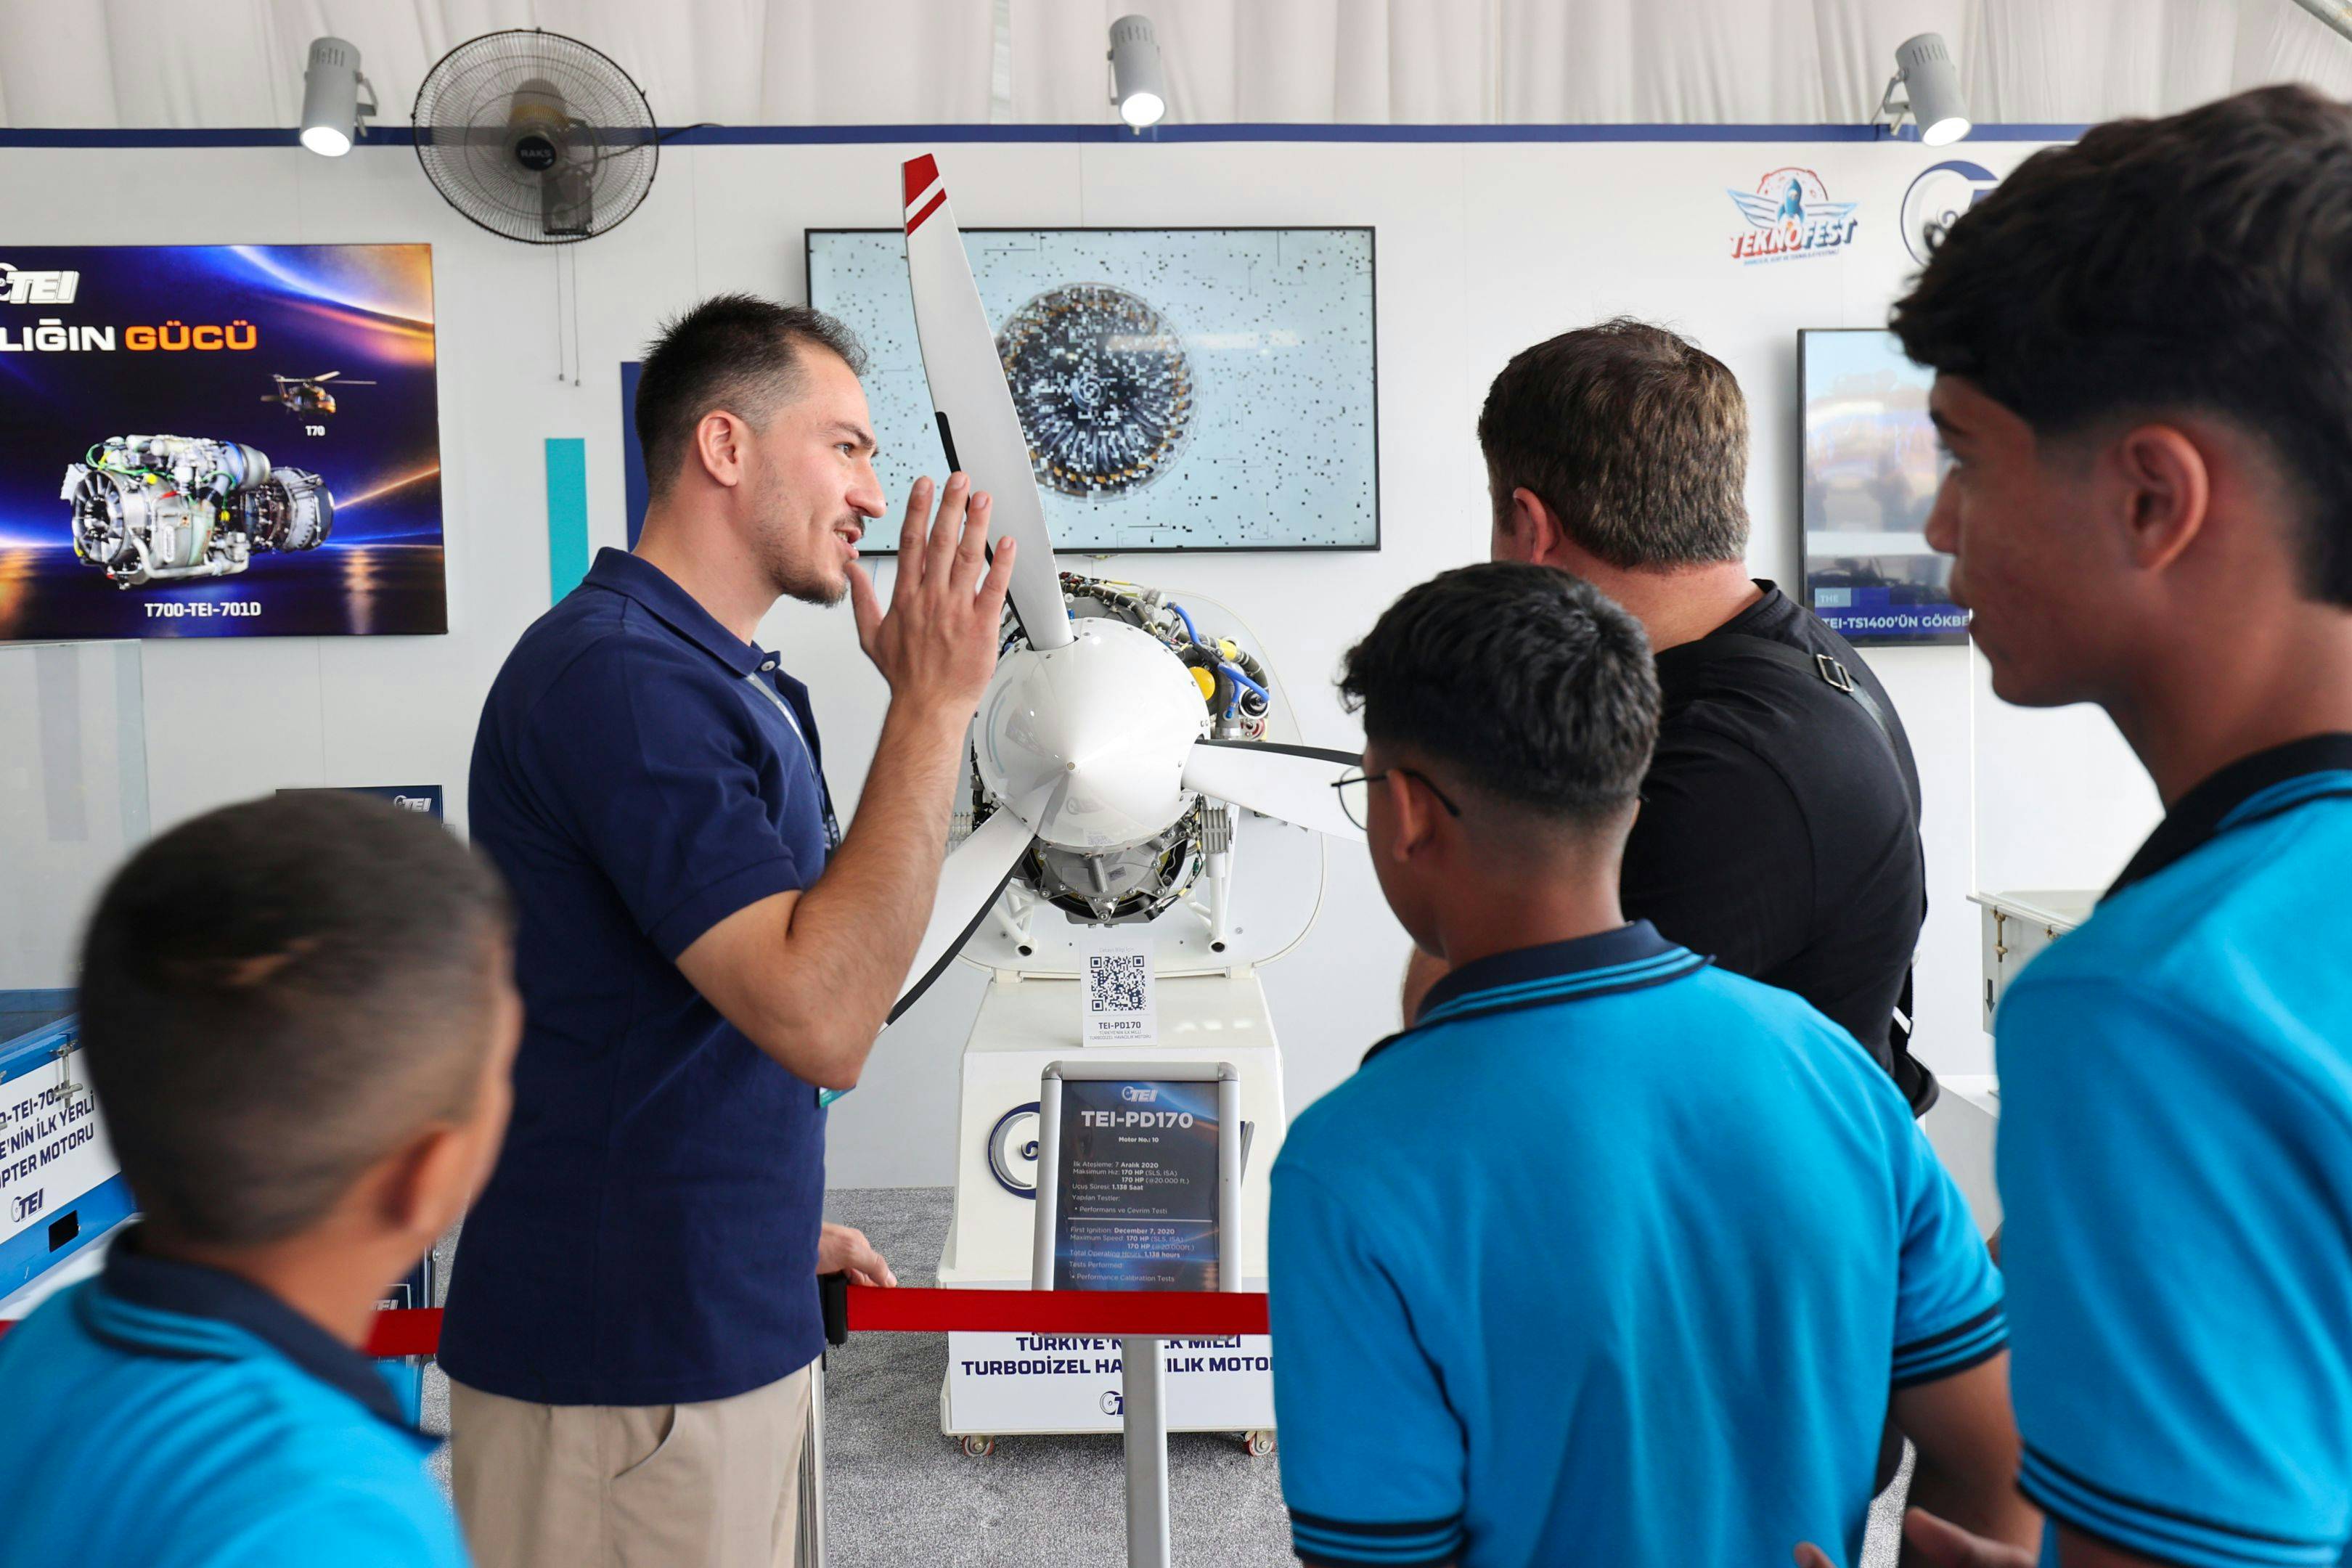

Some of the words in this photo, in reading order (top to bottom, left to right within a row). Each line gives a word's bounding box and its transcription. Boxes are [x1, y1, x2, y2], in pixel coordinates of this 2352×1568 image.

[1730, 219, 1858, 259] TEKNOFEST
[7, 271, 80, 304] TEI
[125, 320, 258, 351] GÜCÜ
[305, 425, 326, 436] T70
[144, 602, 262, 617] T700-TEI-701D
[1922, 613, 1969, 627] GÖKBE
[1130, 1089, 1158, 1102] TEI
[37, 1116, 57, 1140] İLK
[60, 1090, 95, 1126] YERLİ
[1081, 1111, 1193, 1129] TEI-PD170
[40, 1122, 94, 1167] MOTORU
[19, 1188, 44, 1220] TEI
[962, 1355, 1091, 1375] TURBODİZEL
[1209, 1356, 1273, 1372] MOTO
